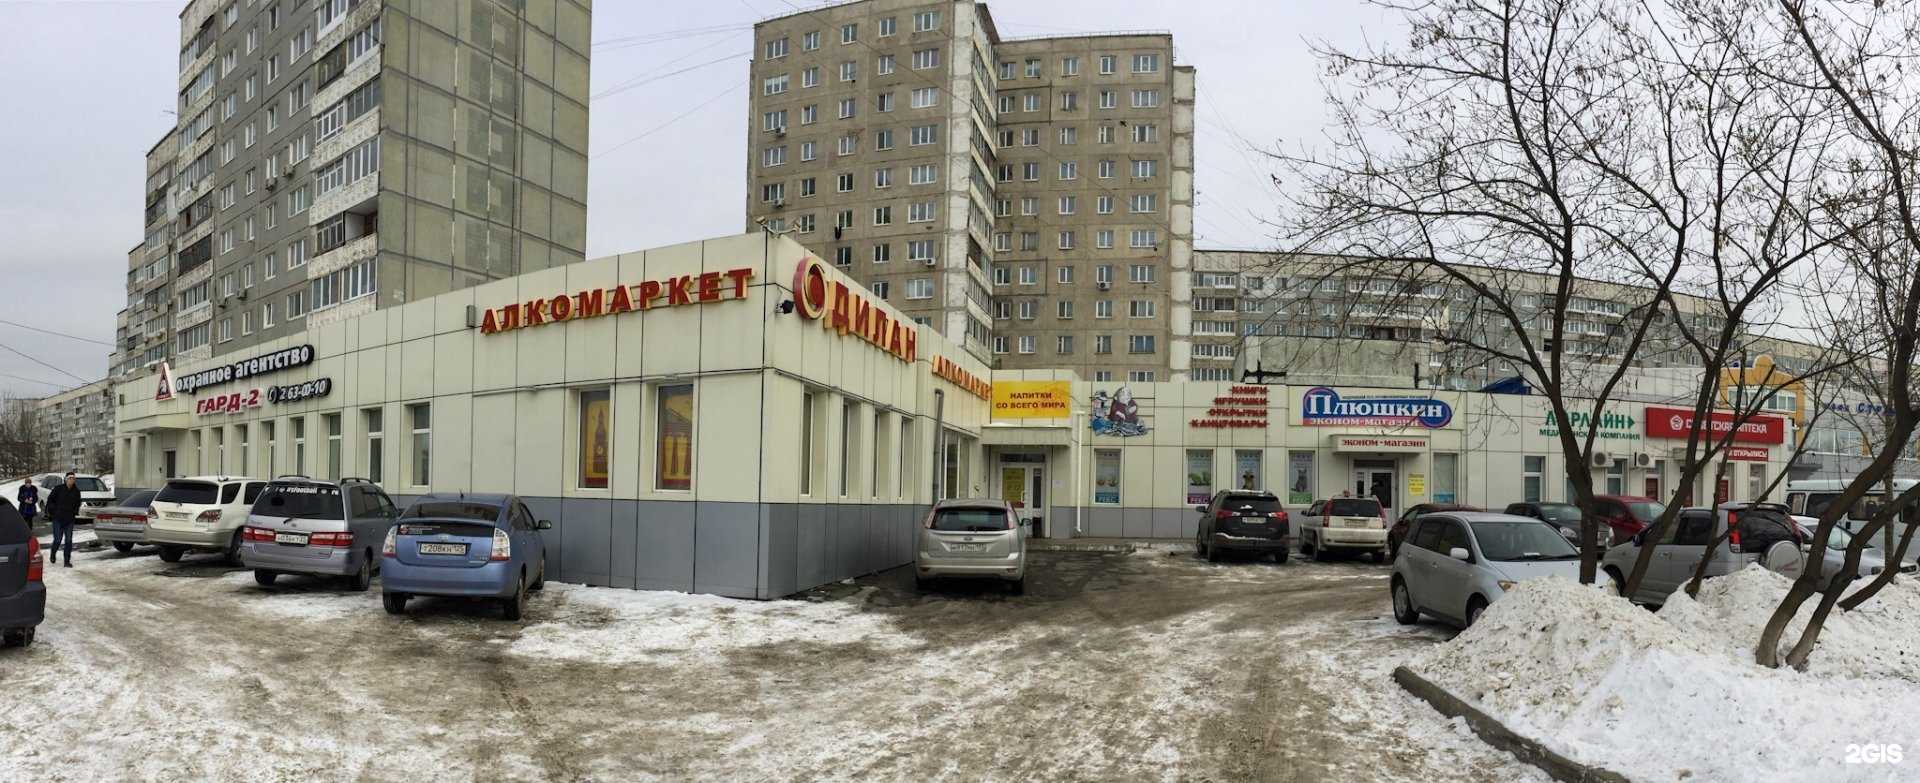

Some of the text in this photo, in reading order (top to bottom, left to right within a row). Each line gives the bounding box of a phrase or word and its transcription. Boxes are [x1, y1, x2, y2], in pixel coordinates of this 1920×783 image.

[480, 267, 755, 336] АЛКОМАРКЕТ
[825, 280, 917, 363] ДИЛАН
[175, 346, 310, 393] охранное агентство
[196, 389, 261, 415] ГАРД-2
[1308, 394, 1444, 418] Плюшкин
[1190, 419, 1267, 428] КАНЦТОВАРЫ
[1600, 431, 1641, 440] КОМПАНИЯ
